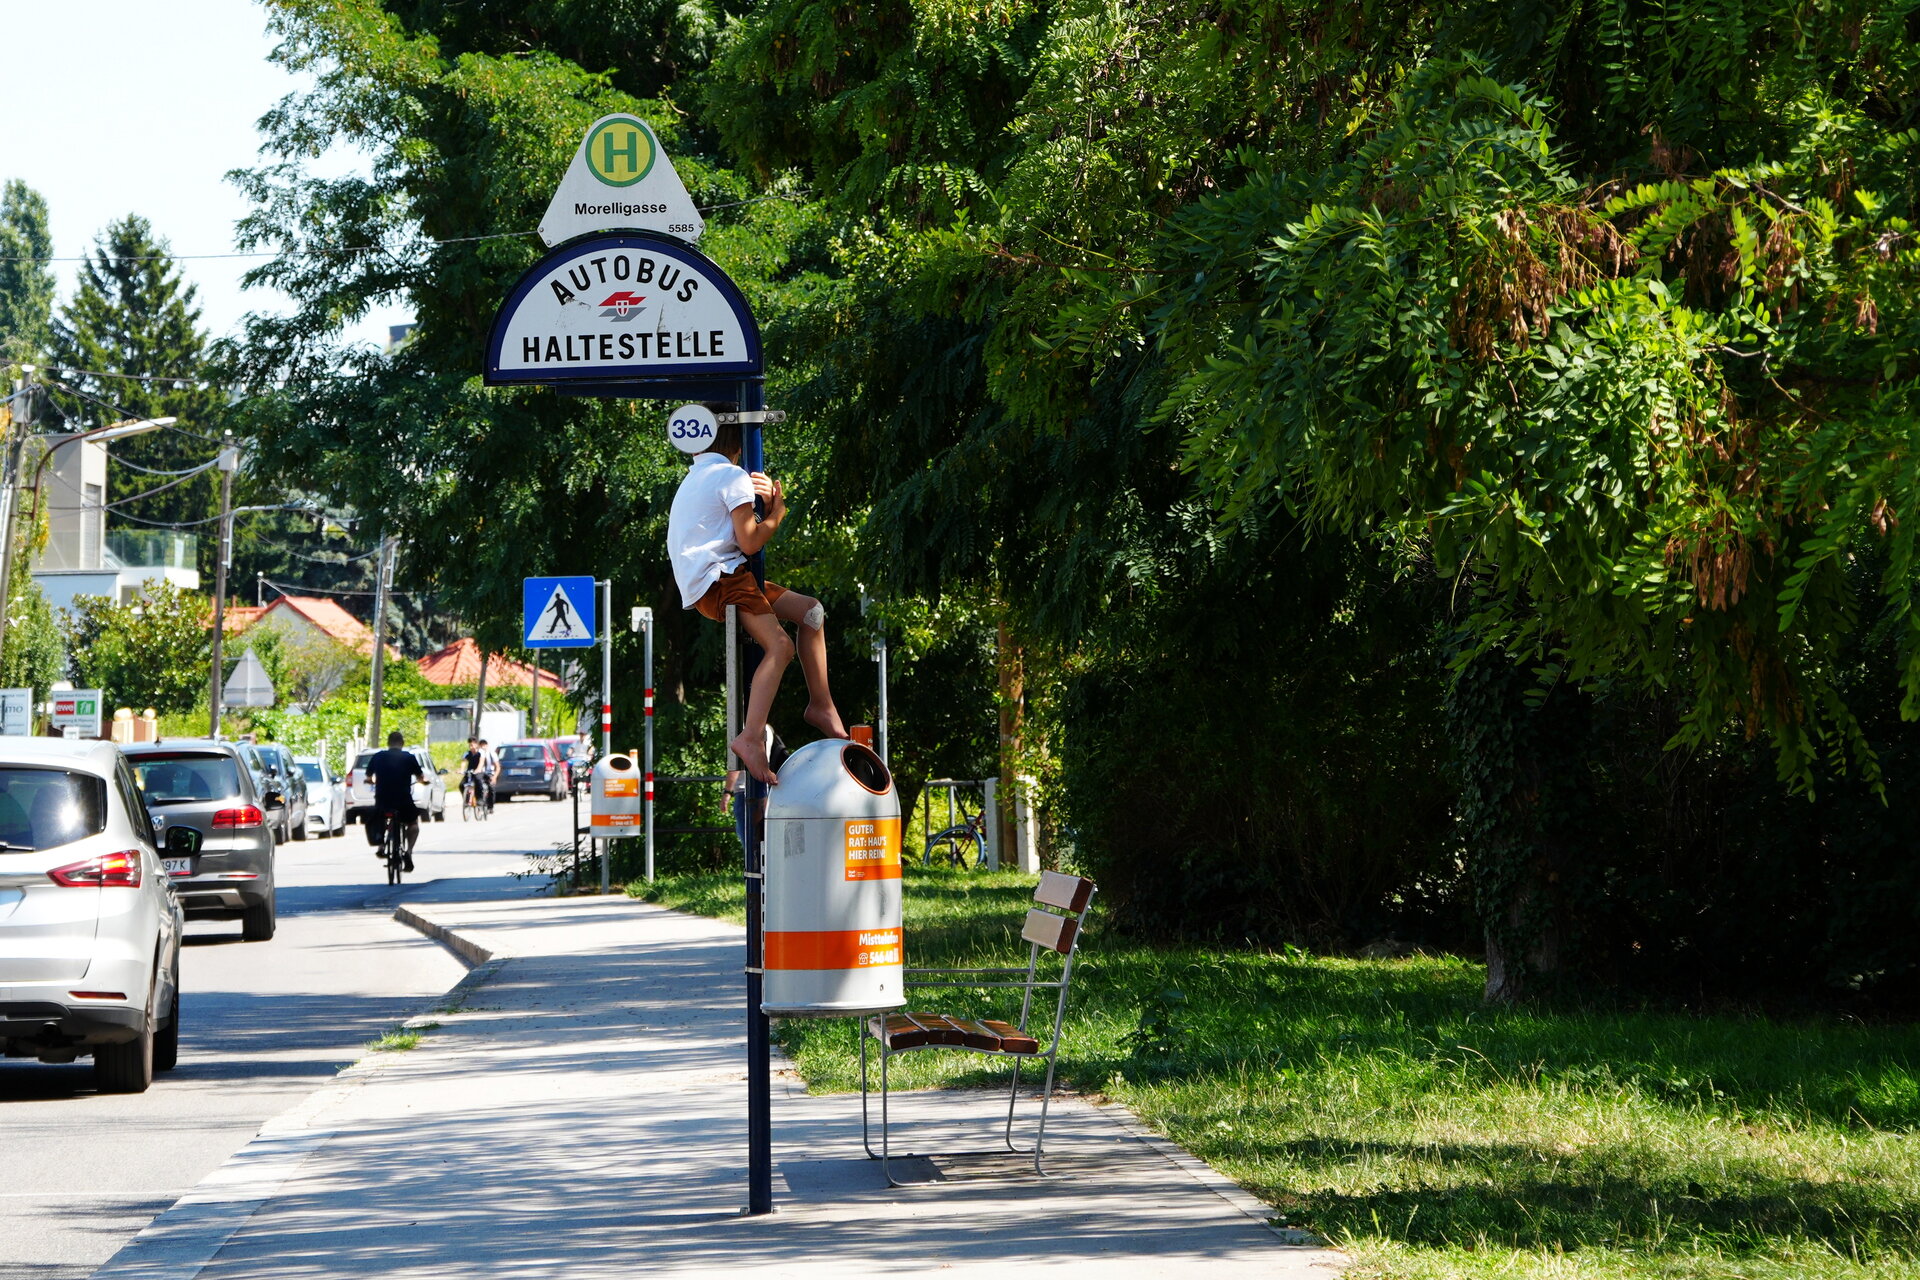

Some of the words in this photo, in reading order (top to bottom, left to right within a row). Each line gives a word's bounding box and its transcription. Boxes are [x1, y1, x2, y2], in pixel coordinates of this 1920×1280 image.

[604, 132, 637, 173] H
[574, 202, 667, 216] Morelligasse
[668, 224, 694, 232] 5585
[550, 255, 699, 306] AUTOBUS
[523, 330, 724, 362] HALTESTELLE
[672, 419, 713, 439] 33A
[848, 824, 874, 835] GUTER
[848, 837, 867, 847] RAT:
[848, 850, 868, 860] HIER
[859, 931, 899, 946] Misttelefon
